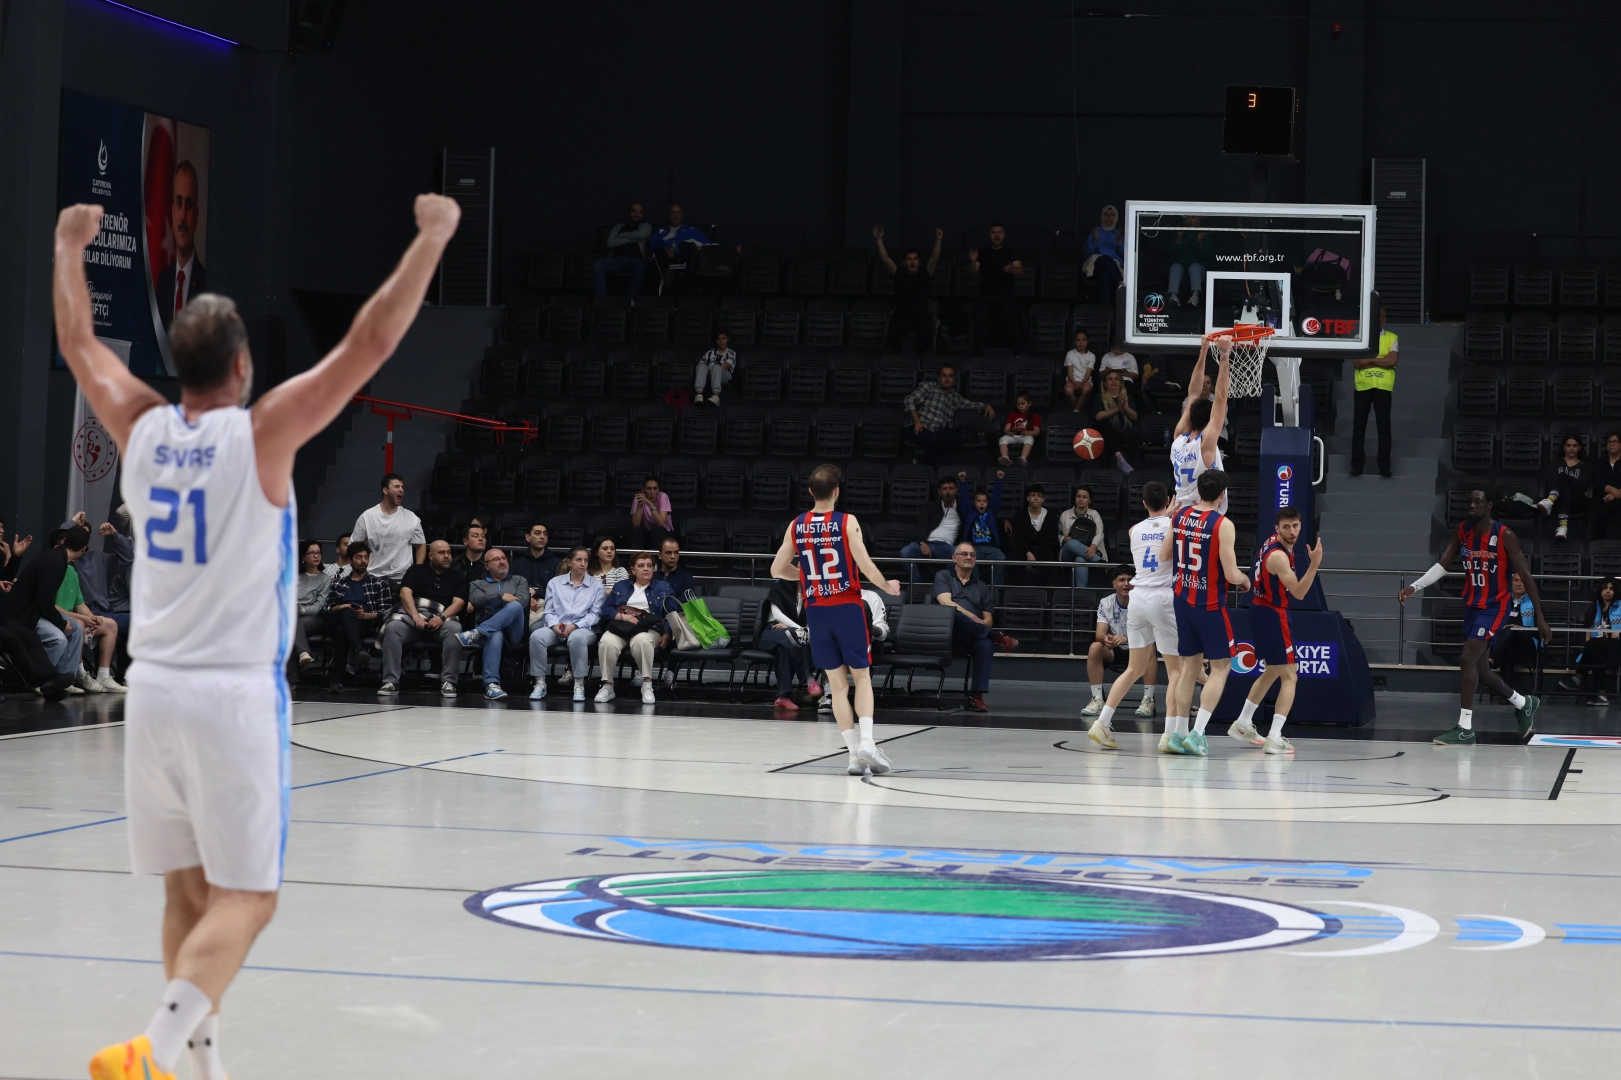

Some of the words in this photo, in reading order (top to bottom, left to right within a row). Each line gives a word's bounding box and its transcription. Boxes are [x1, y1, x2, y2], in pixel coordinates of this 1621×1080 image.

[1248, 93, 1257, 108] 3
[100, 212, 129, 233] TRENÖR
[89, 231, 137, 253] CULARIMIZA
[83, 249, 100, 265] RILAR
[100, 249, 132, 270] DİLİYORUM
[1215, 253, 1285, 264] www.tbf.org.tr
[1321, 319, 1357, 335] TBF
[145, 486, 208, 565] 21
[796, 521, 840, 535] MUSTAFA
[1172, 527, 1212, 540] uropower
[795, 535, 843, 545] europower
[801, 547, 843, 581] 12
[1142, 546, 1159, 573] 4
[1175, 539, 1203, 572] 15
[817, 580, 851, 592] BULLS
[1469, 572, 1486, 587] 10
[1295, 645, 1331, 659] KİYE
[604, 836, 1373, 878] ÇAYIROVA
[989, 866, 1365, 889] SPOR
